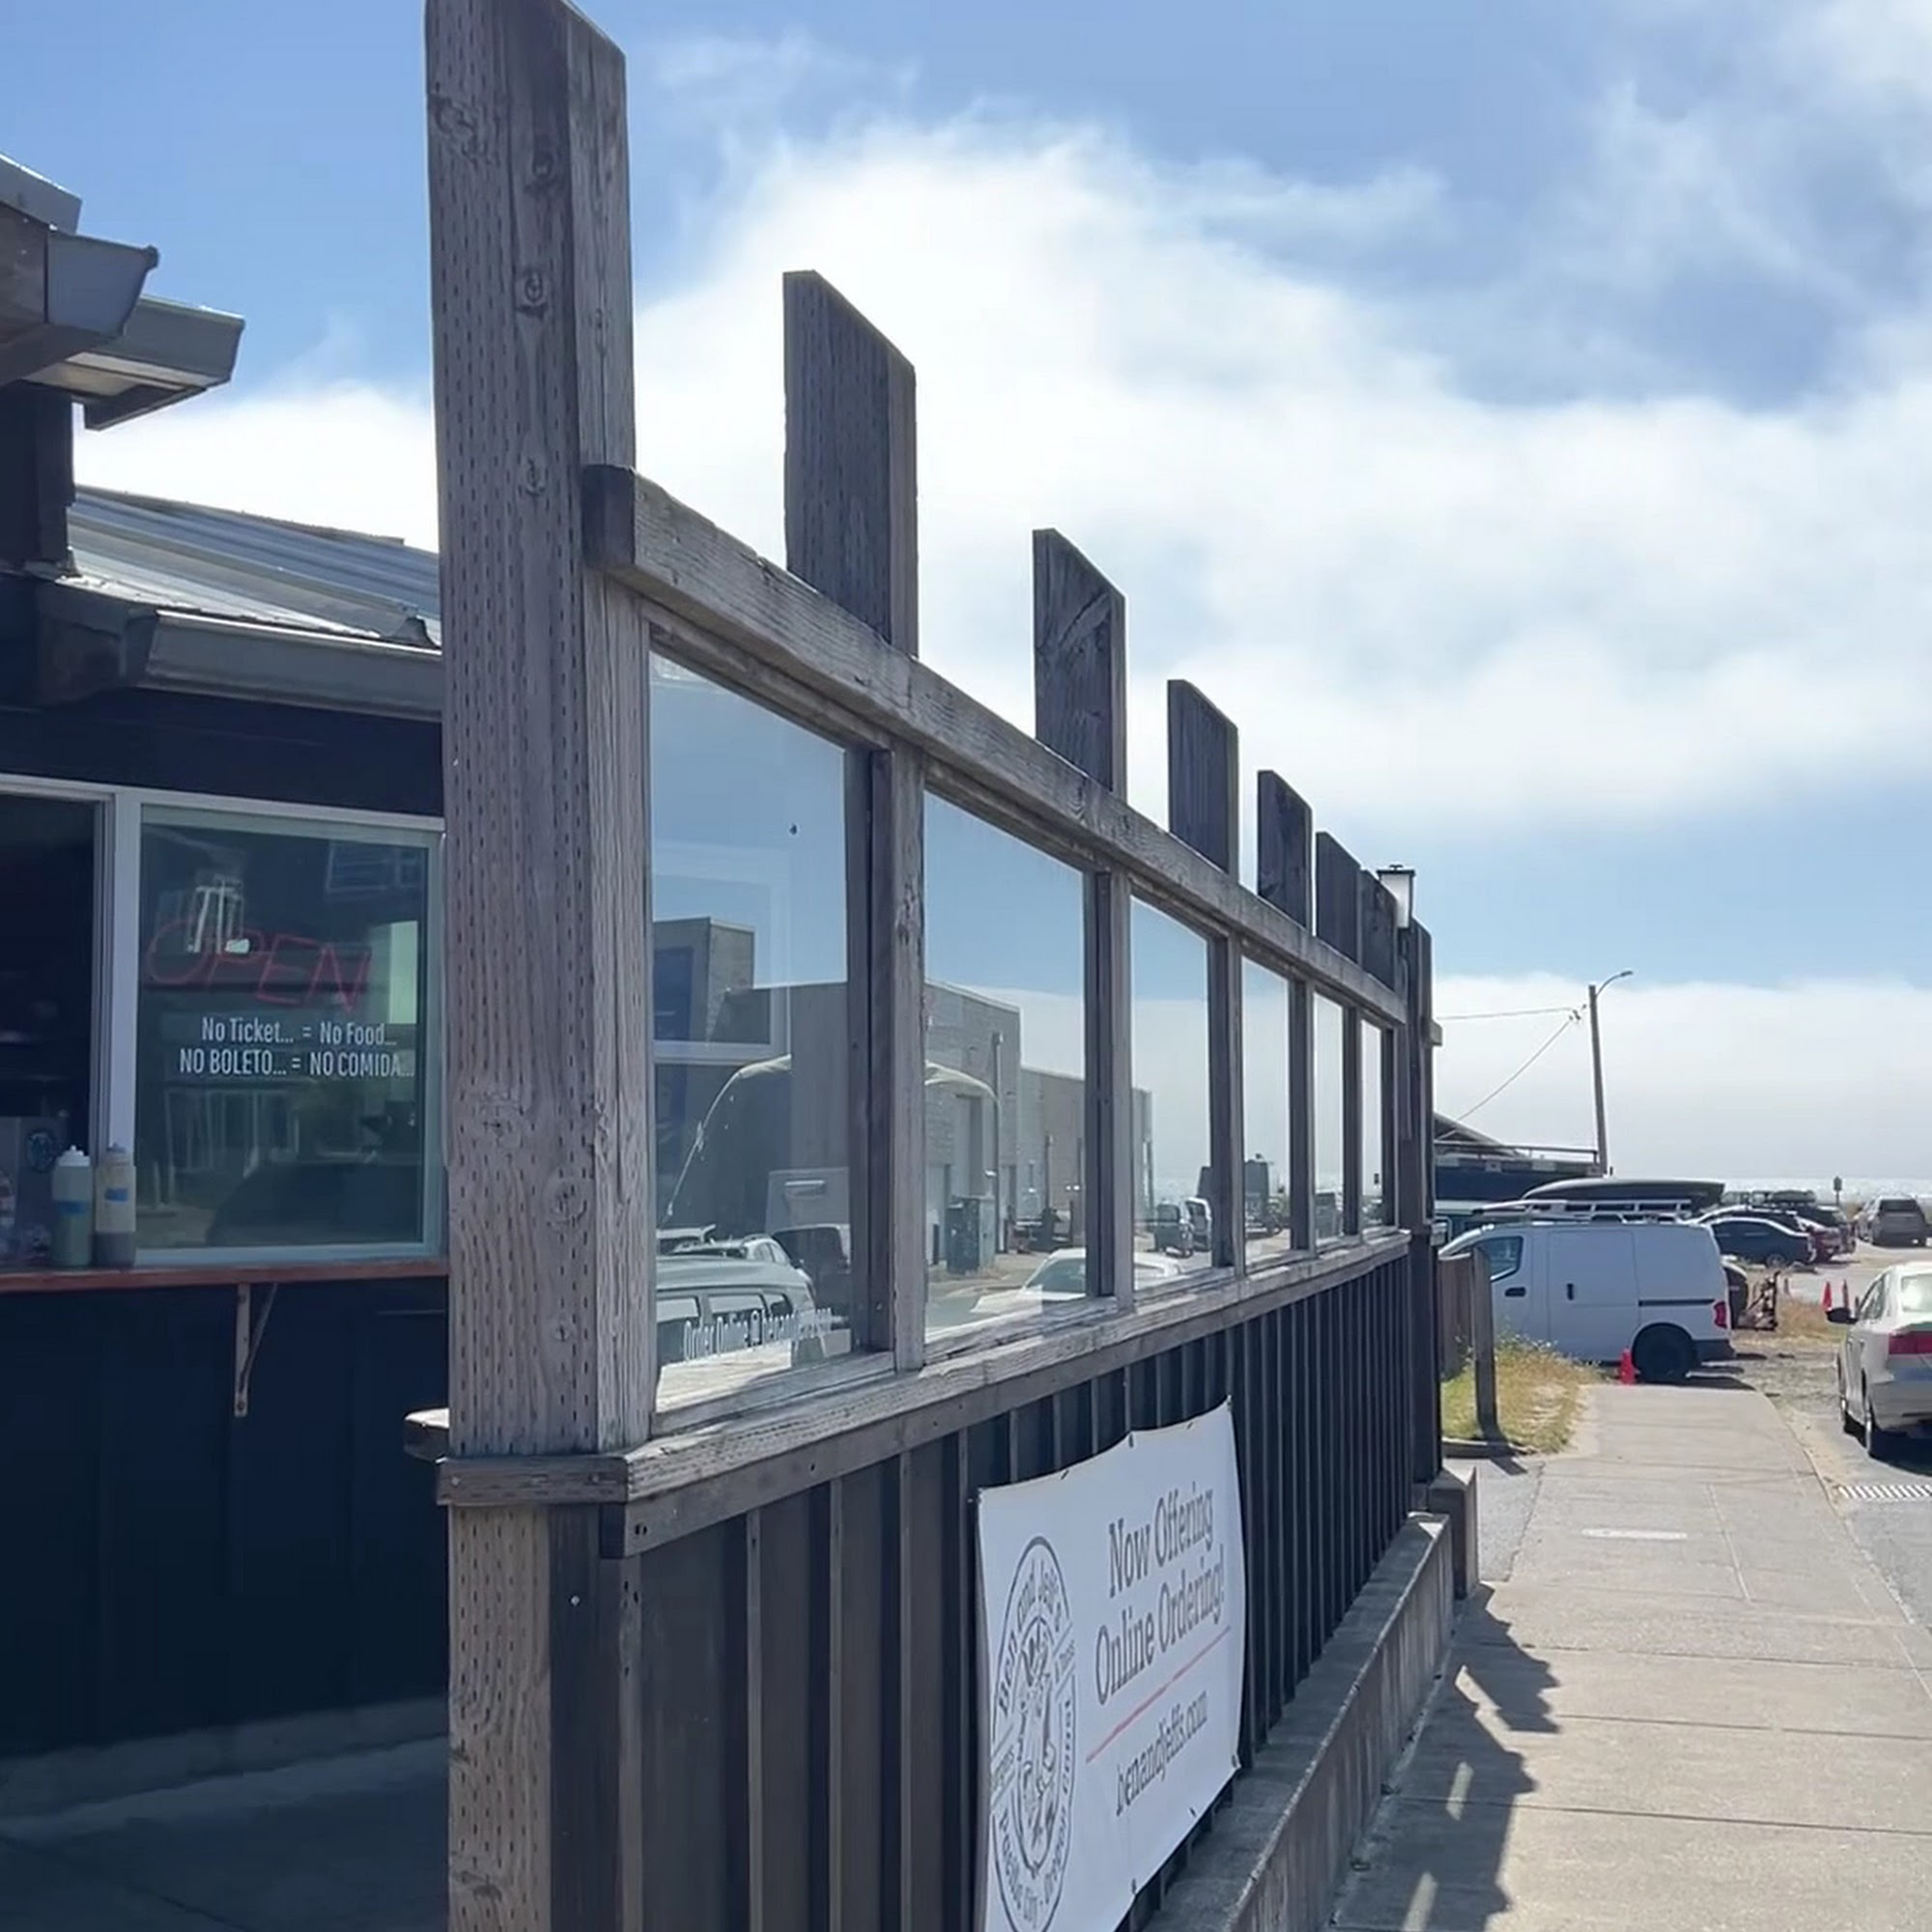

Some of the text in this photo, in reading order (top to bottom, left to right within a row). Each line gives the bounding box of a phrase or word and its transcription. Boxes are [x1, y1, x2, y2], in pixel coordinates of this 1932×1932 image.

[147, 918, 373, 1012] OPEN
[180, 1049, 204, 1074] NO
[210, 1050, 287, 1075] BOLETO...
[292, 1057, 300, 1069] =
[310, 1052, 333, 1076] NO
[201, 1017, 224, 1042] No
[229, 1018, 294, 1043] Ticket...
[302, 1026, 311, 1038] =
[320, 1022, 341, 1045] No
[1109, 1480, 1214, 1599] Now Offering
[1095, 1605, 1155, 1706] Online
[1158, 1543, 1225, 1655] Ordering!
